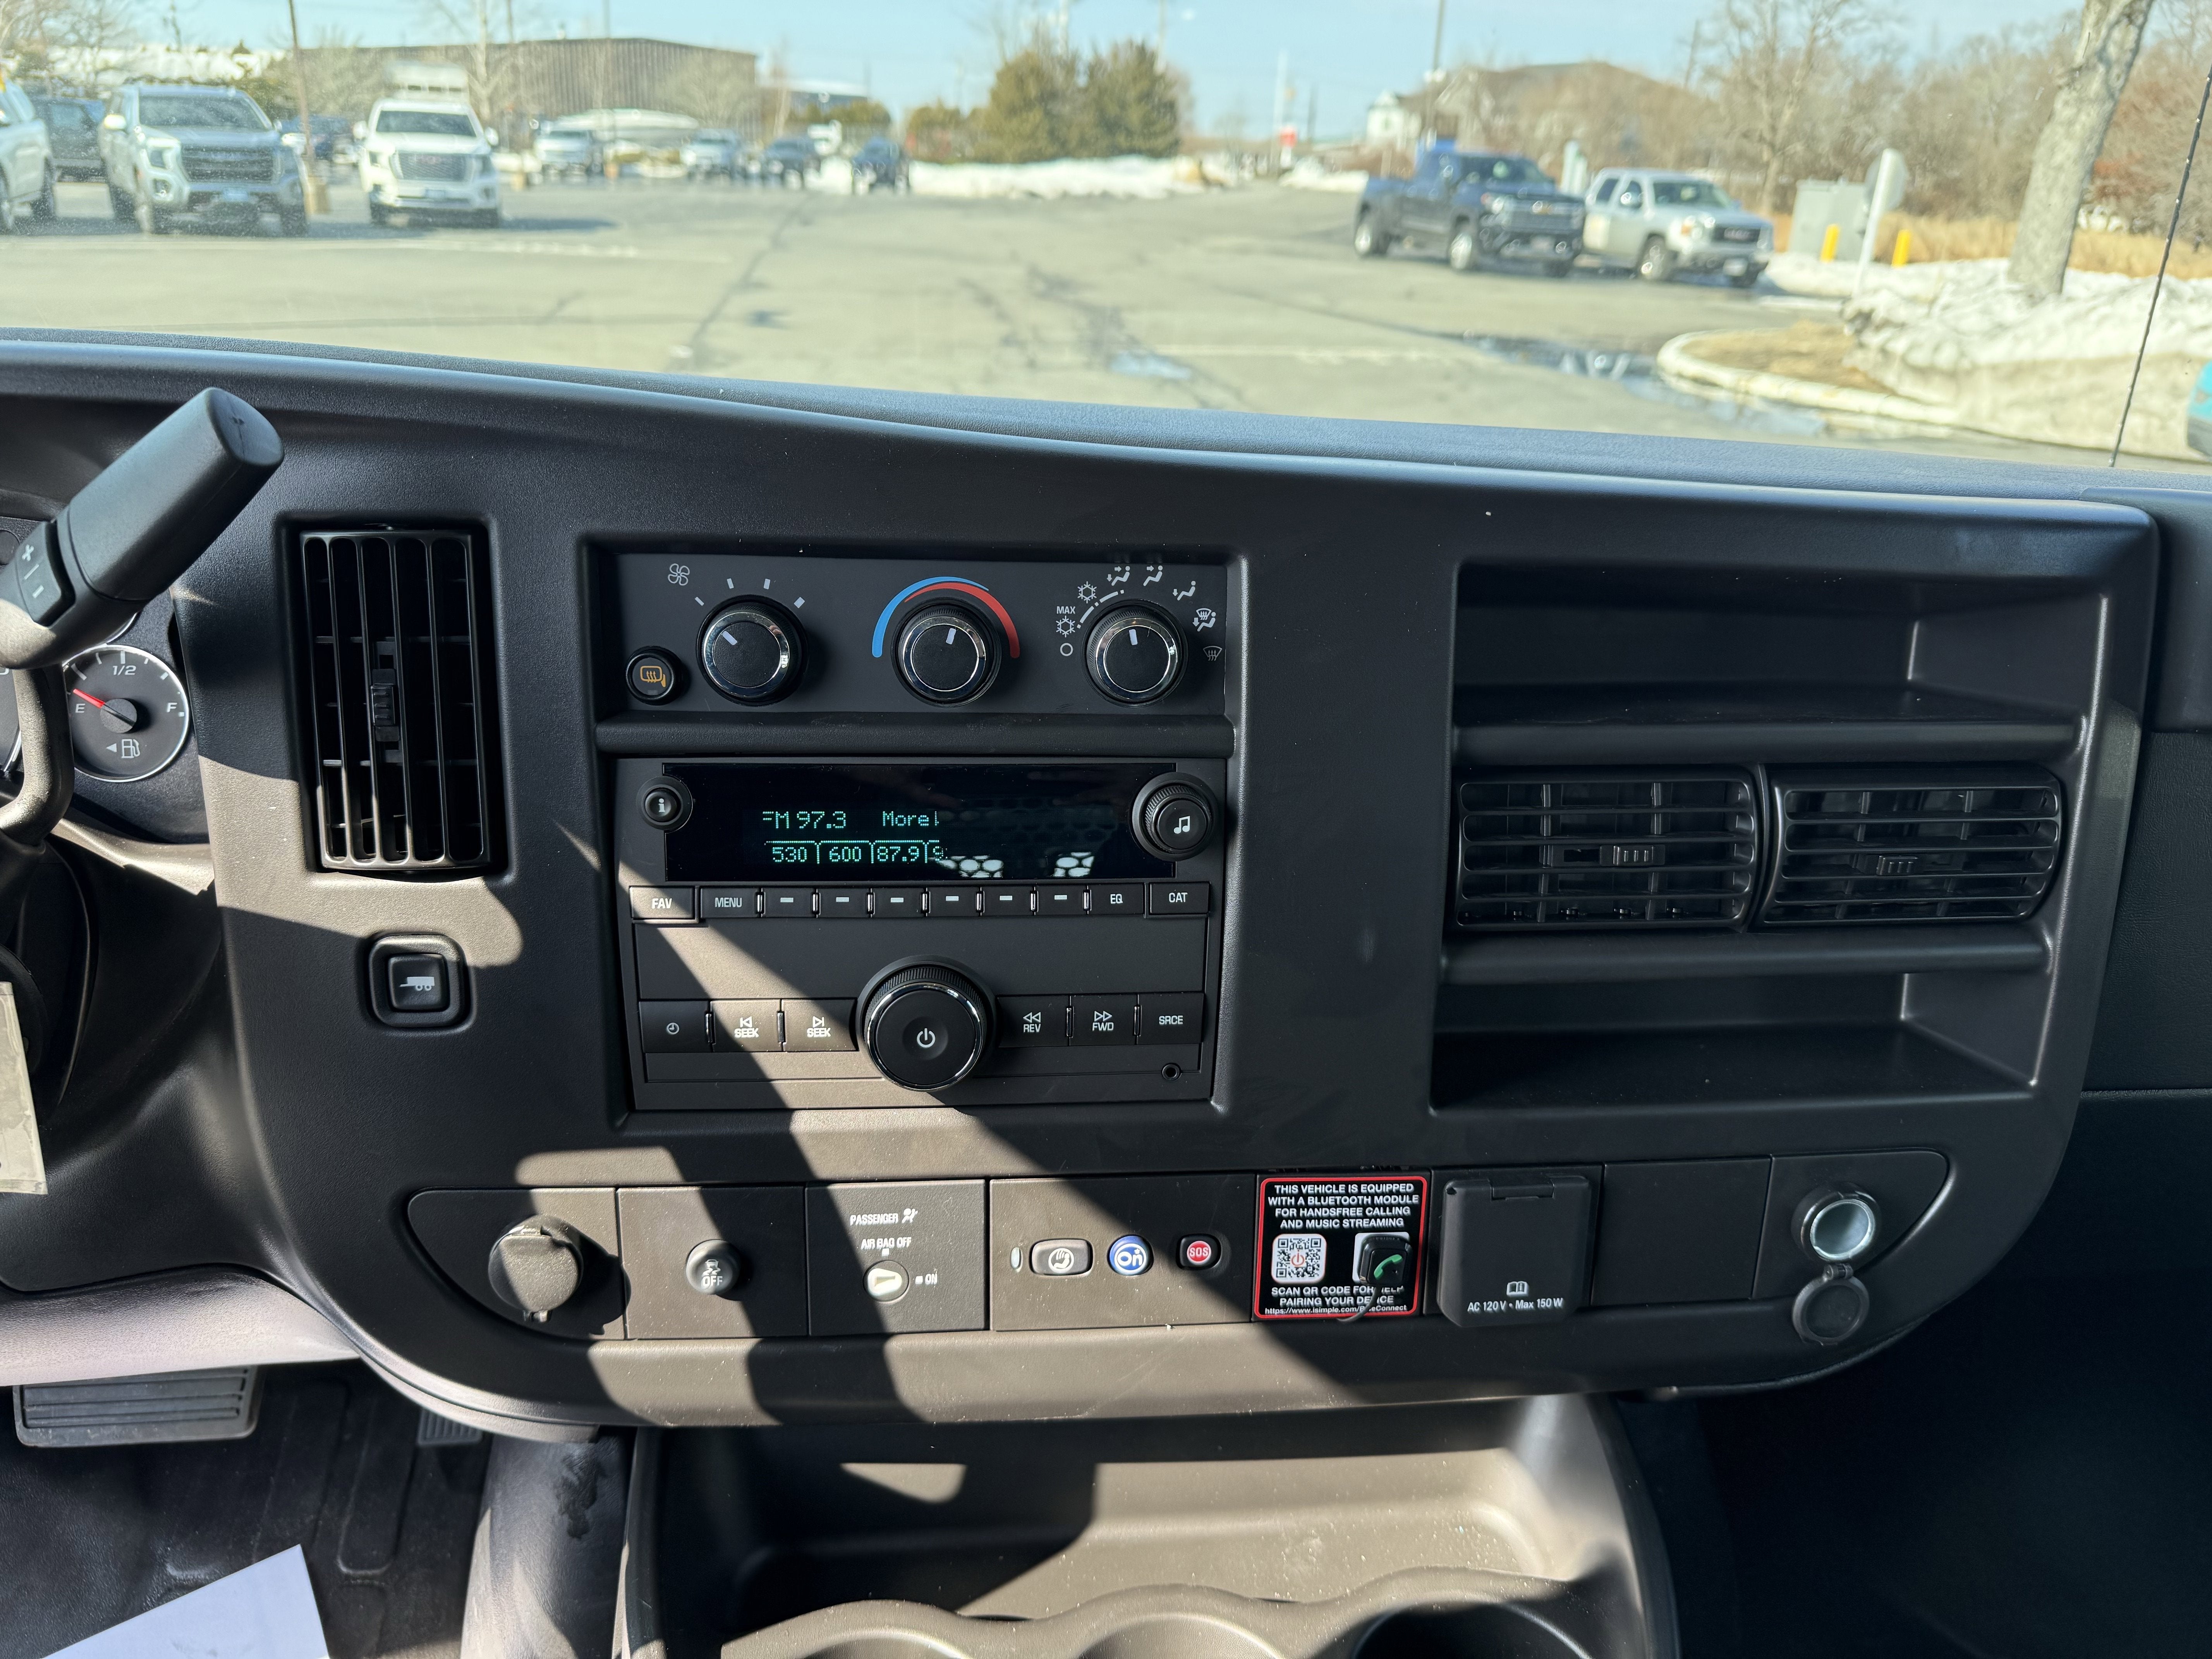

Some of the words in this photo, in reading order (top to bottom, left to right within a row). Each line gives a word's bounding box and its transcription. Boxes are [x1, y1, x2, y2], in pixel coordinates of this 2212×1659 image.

[1056, 606, 1076, 614] MAX
[113, 665, 137, 676] 1/2
[76, 703, 86, 713] E
[166, 702, 178, 713] F
[797, 811, 846, 829] 97.3
[773, 847, 807, 862] 530
[829, 846, 861, 862] 600
[878, 846, 919, 861] 87.9
[715, 897, 742, 907] MENU
[1110, 894, 1123, 904] EQ
[1169, 892, 1188, 903] CAT
[652, 898, 672, 909] FAV
[1159, 1015, 1183, 1025] SRCE
[1023, 1024, 1041, 1033] REV
[1092, 1022, 1114, 1031] FWD
[734, 1027, 759, 1038] SEEK
[807, 1027, 831, 1038] SEEK
[1274, 1185, 1298, 1194] THIS
[1301, 1184, 1346, 1194] VEHICLE
[1348, 1184, 1358, 1193] IS
[1361, 1183, 1414, 1193] EQUIPPED
[1268, 1197, 1295, 1206] WITH
[1297, 1197, 1305, 1206] A
[1307, 1195, 1371, 1205] BLUETOOTH
[1374, 1195, 1419, 1204] MODULE
[1275, 1209, 1297, 1218] FOR
[1300, 1207, 1363, 1217] HANDSFREE
[1365, 1207, 1411, 1216] CALLING
[850, 1213, 899, 1226] PASSENGER
[1280, 1220, 1303, 1229] AND
[1306, 1219, 1340, 1228] MUSIC
[1343, 1218, 1404, 1228] STREAMING
[860, 1238, 876, 1250] AIR
[876, 1237, 895, 1249] BAG
[896, 1237, 912, 1248] OFF
[1189, 1247, 1209, 1257] SOS
[702, 1276, 723, 1288] OFF
[925, 1273, 938, 1285] ON
[1271, 1287, 1300, 1297] SCAN
[1303, 1287, 1318, 1296] QR
[1321, 1286, 1350, 1296] CODE
[1280, 1297, 1322, 1307] PAIRING
[1324, 1297, 1354, 1306] YOUR
[1467, 1302, 1480, 1312] AC
[1515, 1300, 1534, 1310] Max
